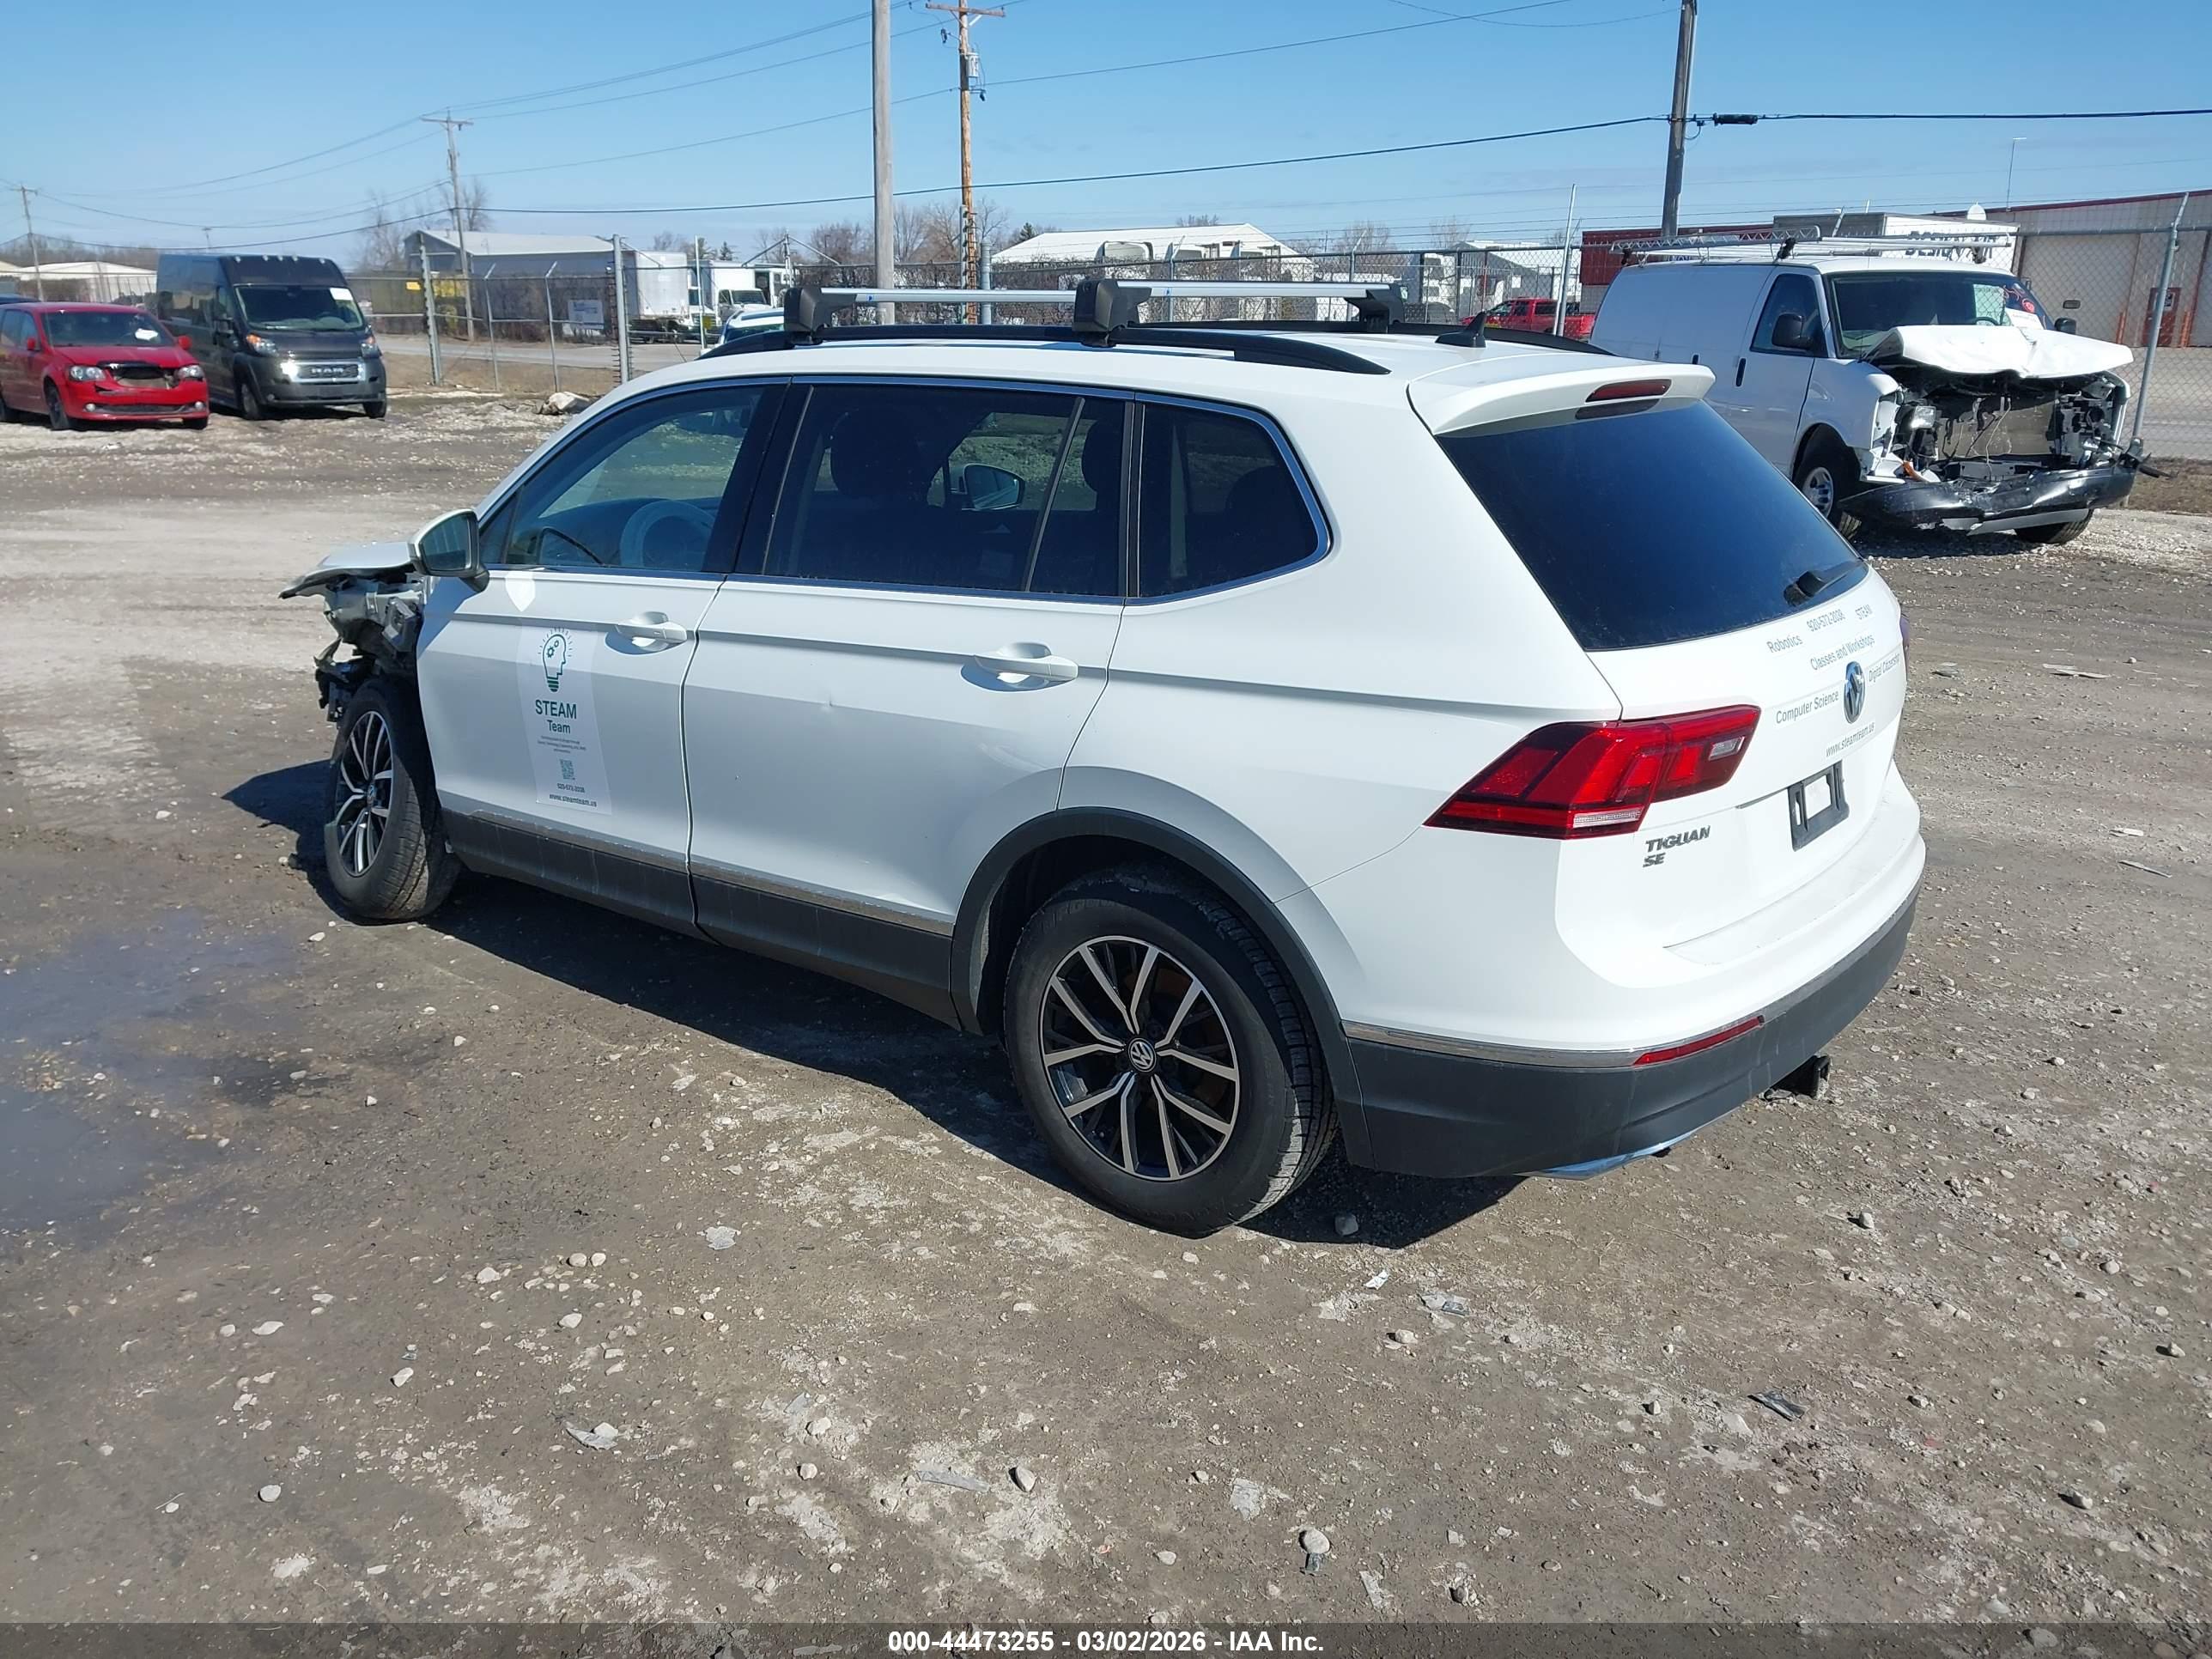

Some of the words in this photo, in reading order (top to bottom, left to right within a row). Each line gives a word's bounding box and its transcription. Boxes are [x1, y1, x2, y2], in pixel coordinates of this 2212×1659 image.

[1766, 635, 1803, 653] Robotics
[1810, 653, 1836, 671] Classes
[1836, 645, 1848, 659] and
[1846, 634, 1875, 654] Workshops
[535, 698, 577, 720] STEAM
[1776, 700, 1813, 724] Computer
[1814, 690, 1839, 710] Science
[546, 720, 571, 734] Team
[1644, 824, 1711, 853] TIGUAN
[1642, 852, 1666, 868] SE
